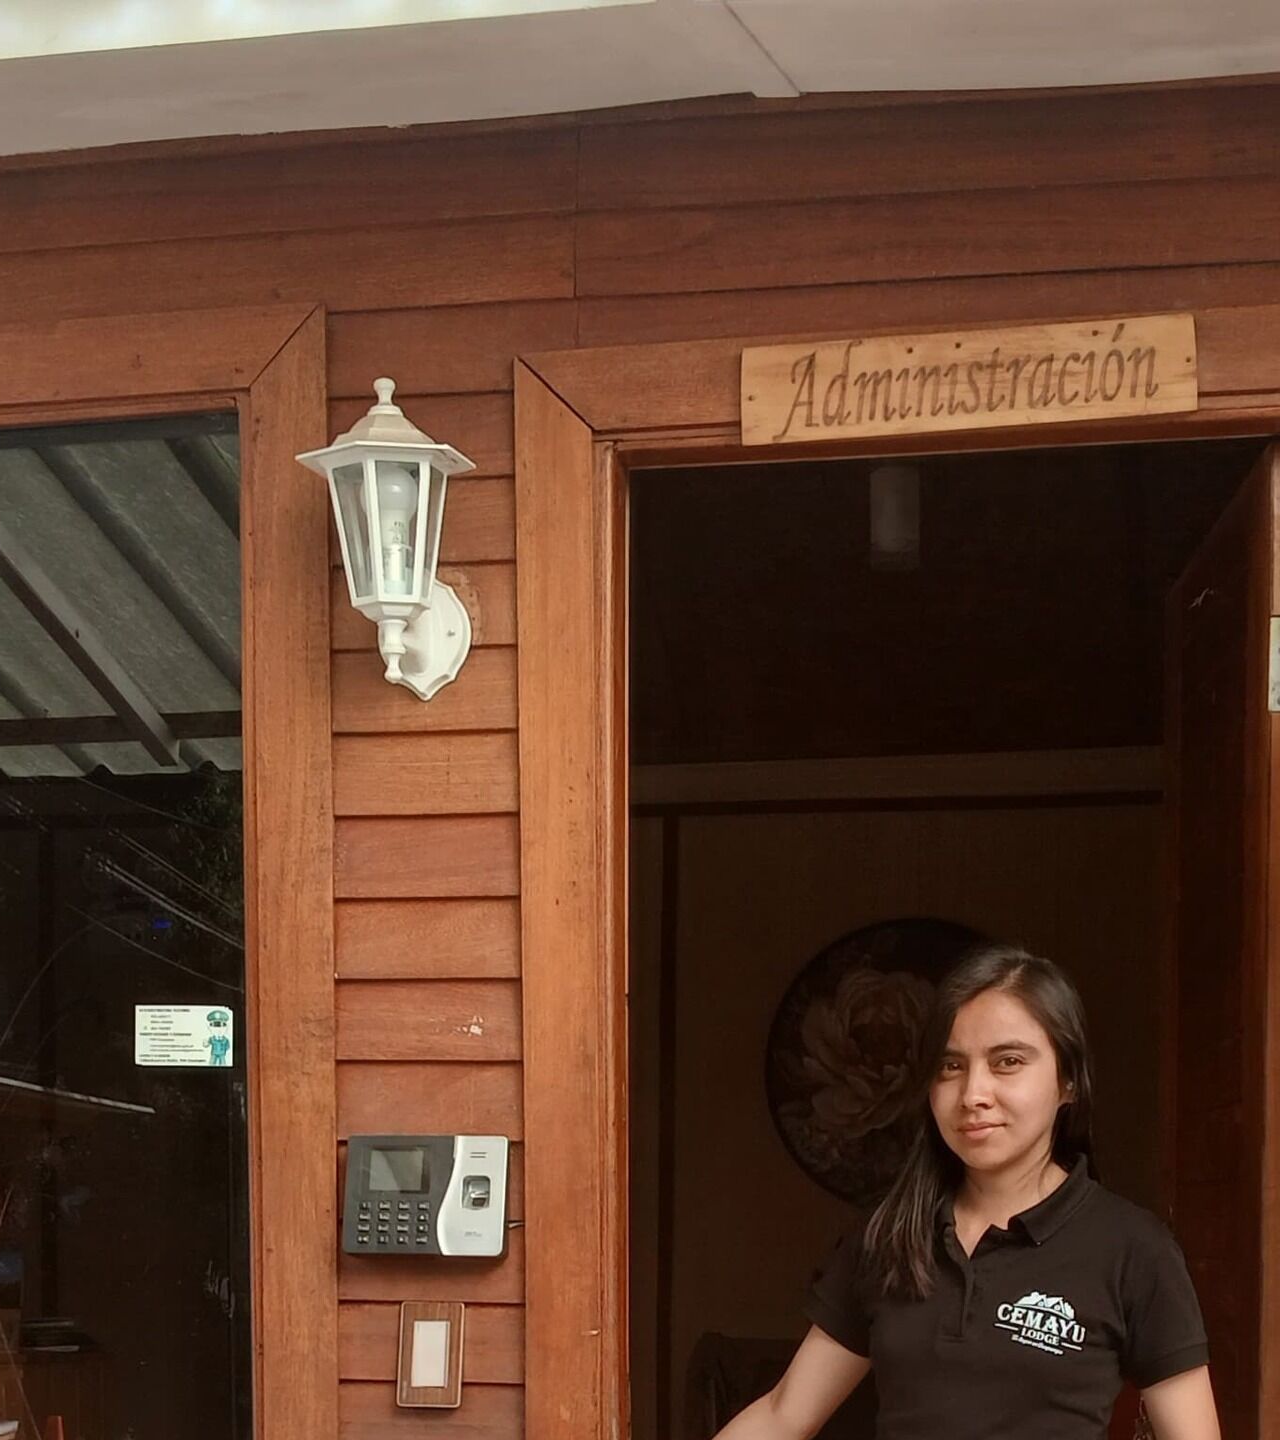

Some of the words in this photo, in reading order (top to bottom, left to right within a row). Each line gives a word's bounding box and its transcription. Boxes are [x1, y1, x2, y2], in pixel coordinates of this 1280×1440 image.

[772, 323, 1160, 441] Administración
[997, 1303, 1086, 1343] CEMAYU
[1021, 1327, 1060, 1346] LODGE
